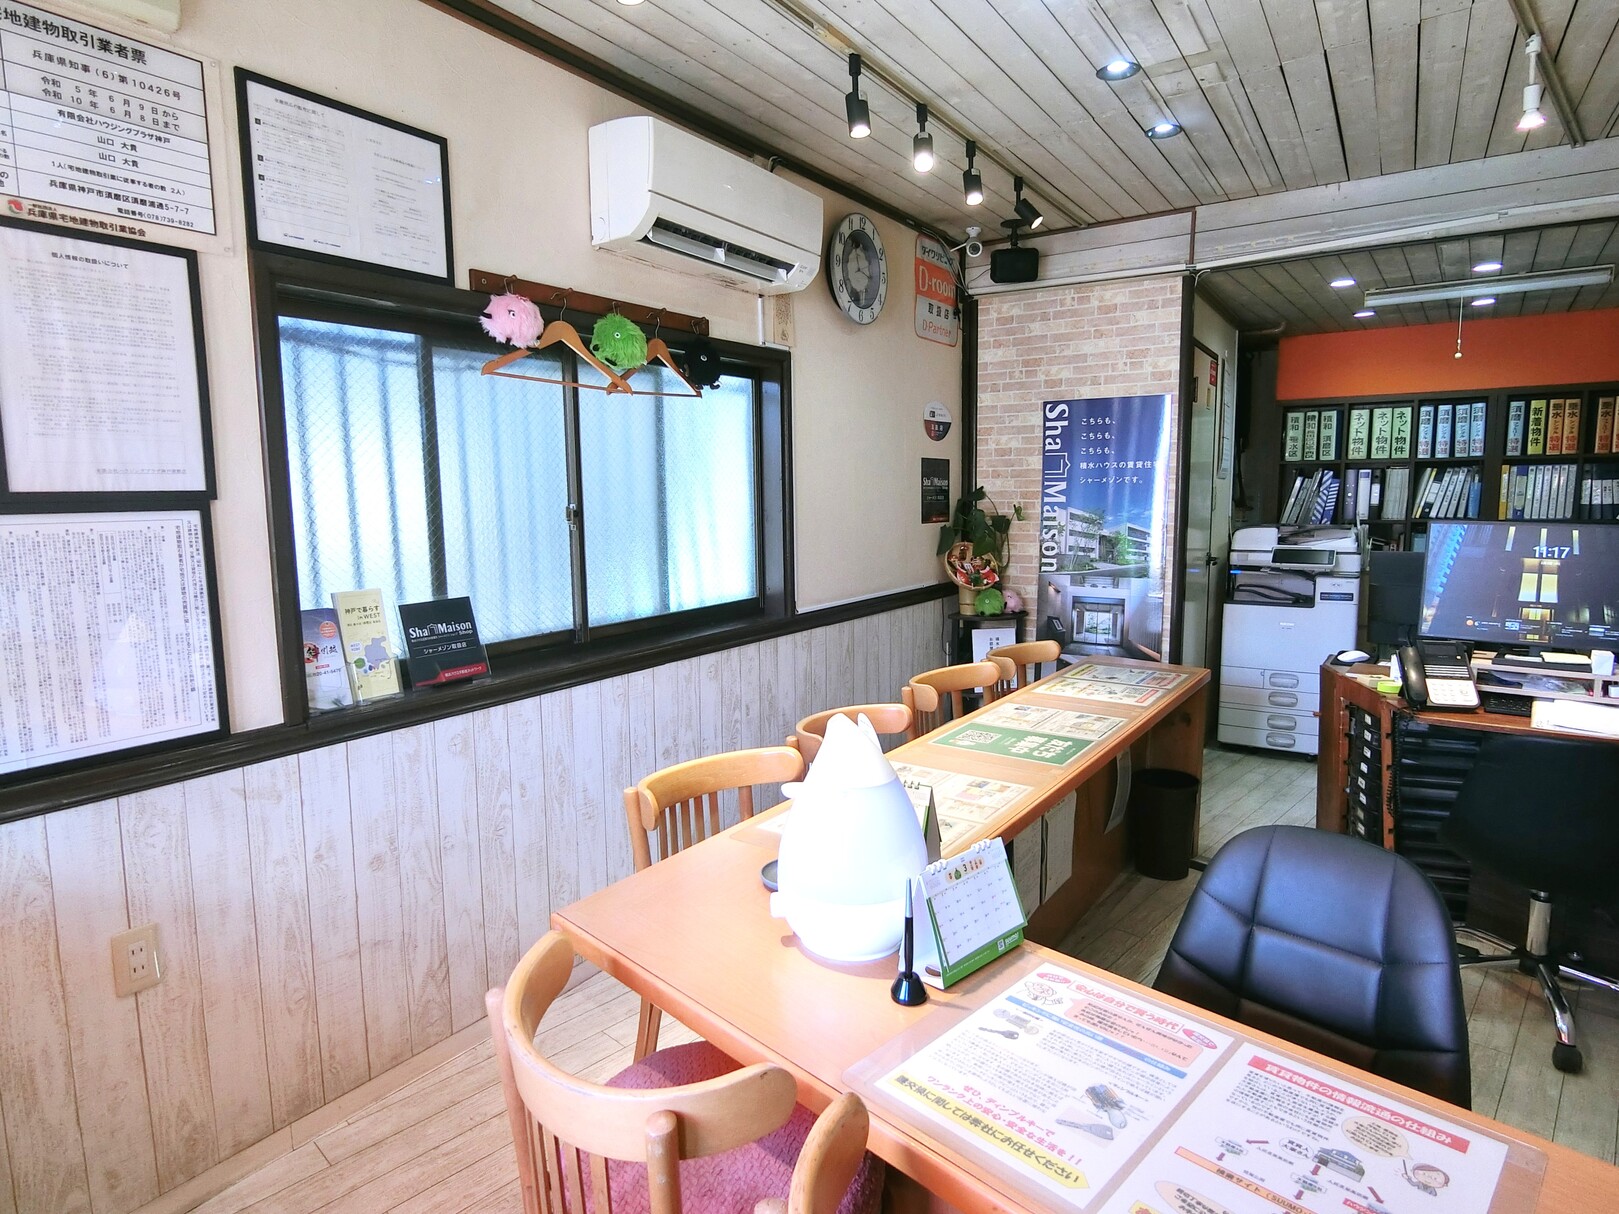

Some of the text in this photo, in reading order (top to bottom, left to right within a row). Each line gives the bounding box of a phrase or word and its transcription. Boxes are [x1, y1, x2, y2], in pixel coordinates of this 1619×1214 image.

[0, 7, 147, 65] 地建物取引業者票
[57, 109, 171, 144] 有限会社ハウジングプラザ神戸
[97, 135, 115, 146] 山口
[98, 152, 116, 163] 山口
[27, 208, 147, 238] 兵庫県宅地建物取引業協会
[1351, 412, 1365, 456] ネット物件
[1375, 411, 1389, 455] ネット物件
[1394, 410, 1407, 455] ネット物件
[1530, 406, 1544, 447] 新着物件
[1041, 402, 1069, 573] Sha Maison
[1532, 545, 1571, 559] 11:17
[344, 604, 380, 616] 神戸で暮らす
[409, 626, 429, 639] Sha
[437, 621, 472, 634] Maison
